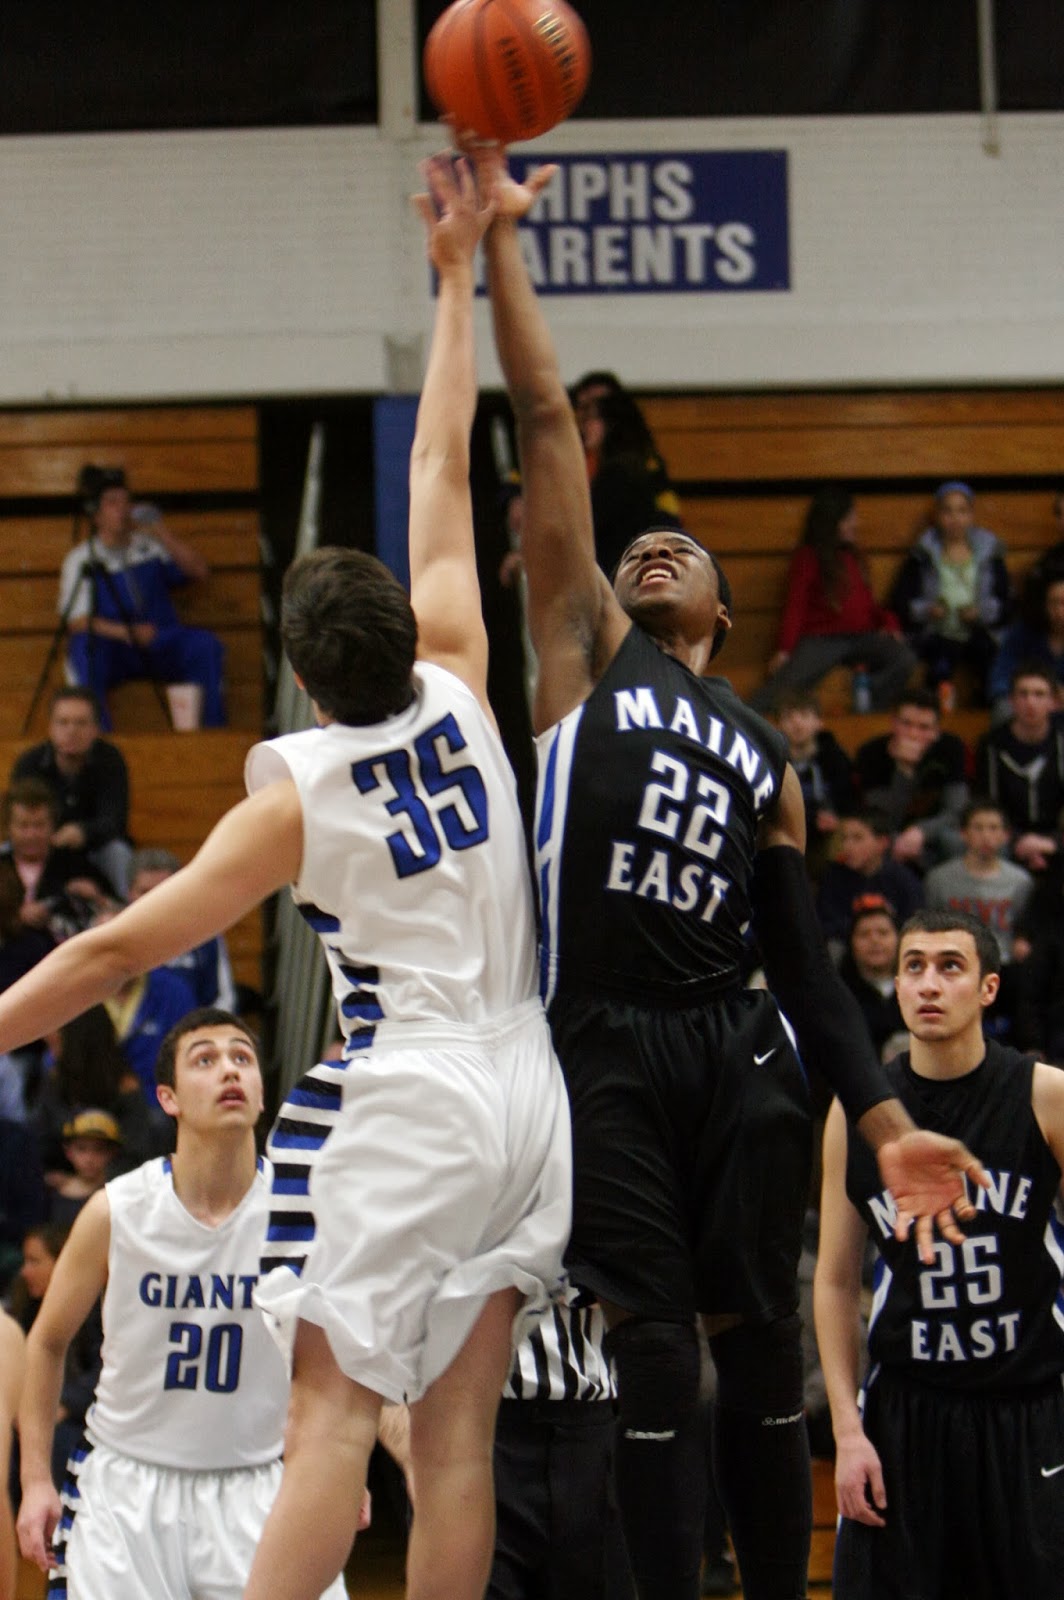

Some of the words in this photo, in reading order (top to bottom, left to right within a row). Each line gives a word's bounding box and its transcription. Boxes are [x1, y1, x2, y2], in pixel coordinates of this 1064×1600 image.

[474, 222, 756, 286] ARENTS
[350, 711, 489, 880] 35
[637, 750, 731, 862] 22
[606, 842, 730, 924] EAST
[138, 1271, 259, 1311] GIANT
[917, 1235, 1002, 1310] 25
[163, 1321, 243, 1394] 20
[911, 1312, 1021, 1362] EAST
